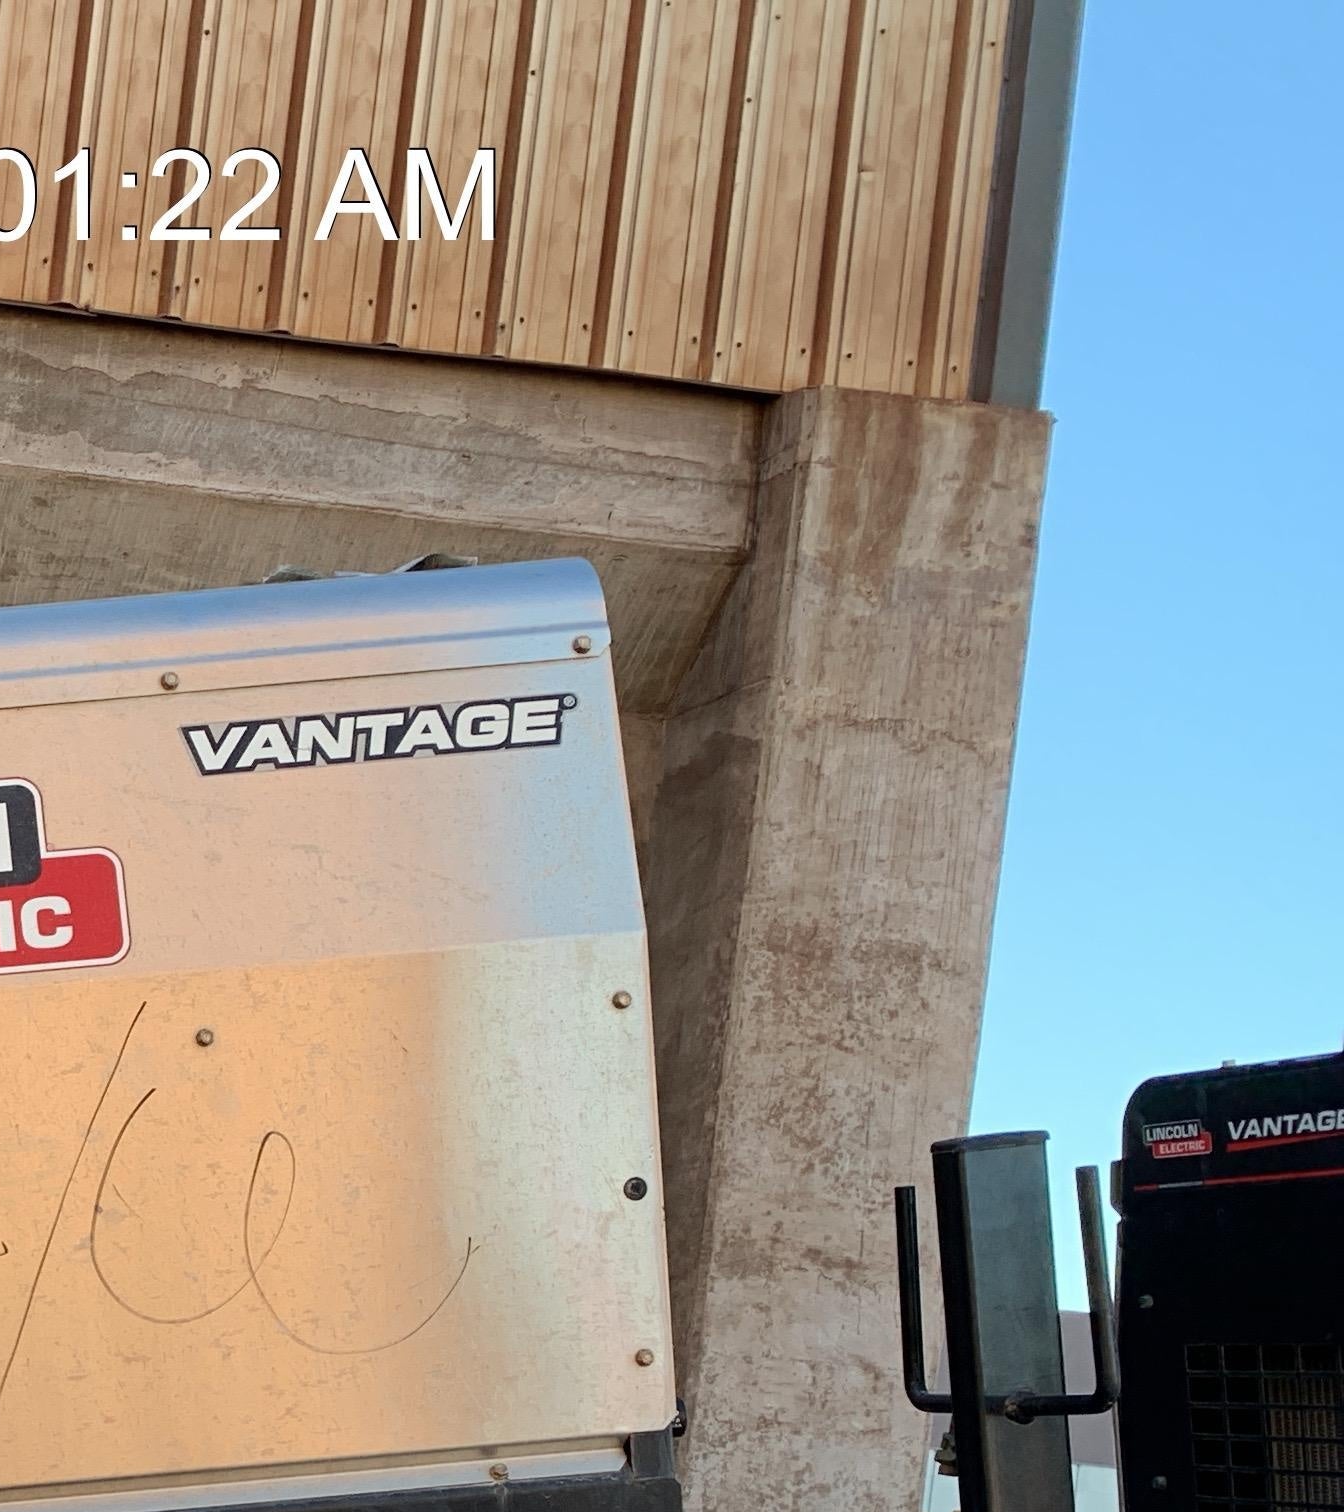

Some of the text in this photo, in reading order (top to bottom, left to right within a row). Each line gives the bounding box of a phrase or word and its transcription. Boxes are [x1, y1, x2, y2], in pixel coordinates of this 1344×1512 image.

[188, 698, 562, 771] VANTAGE
[1146, 1123, 1199, 1142] LINCOLN
[1159, 1140, 1206, 1155] ELECTRIC
